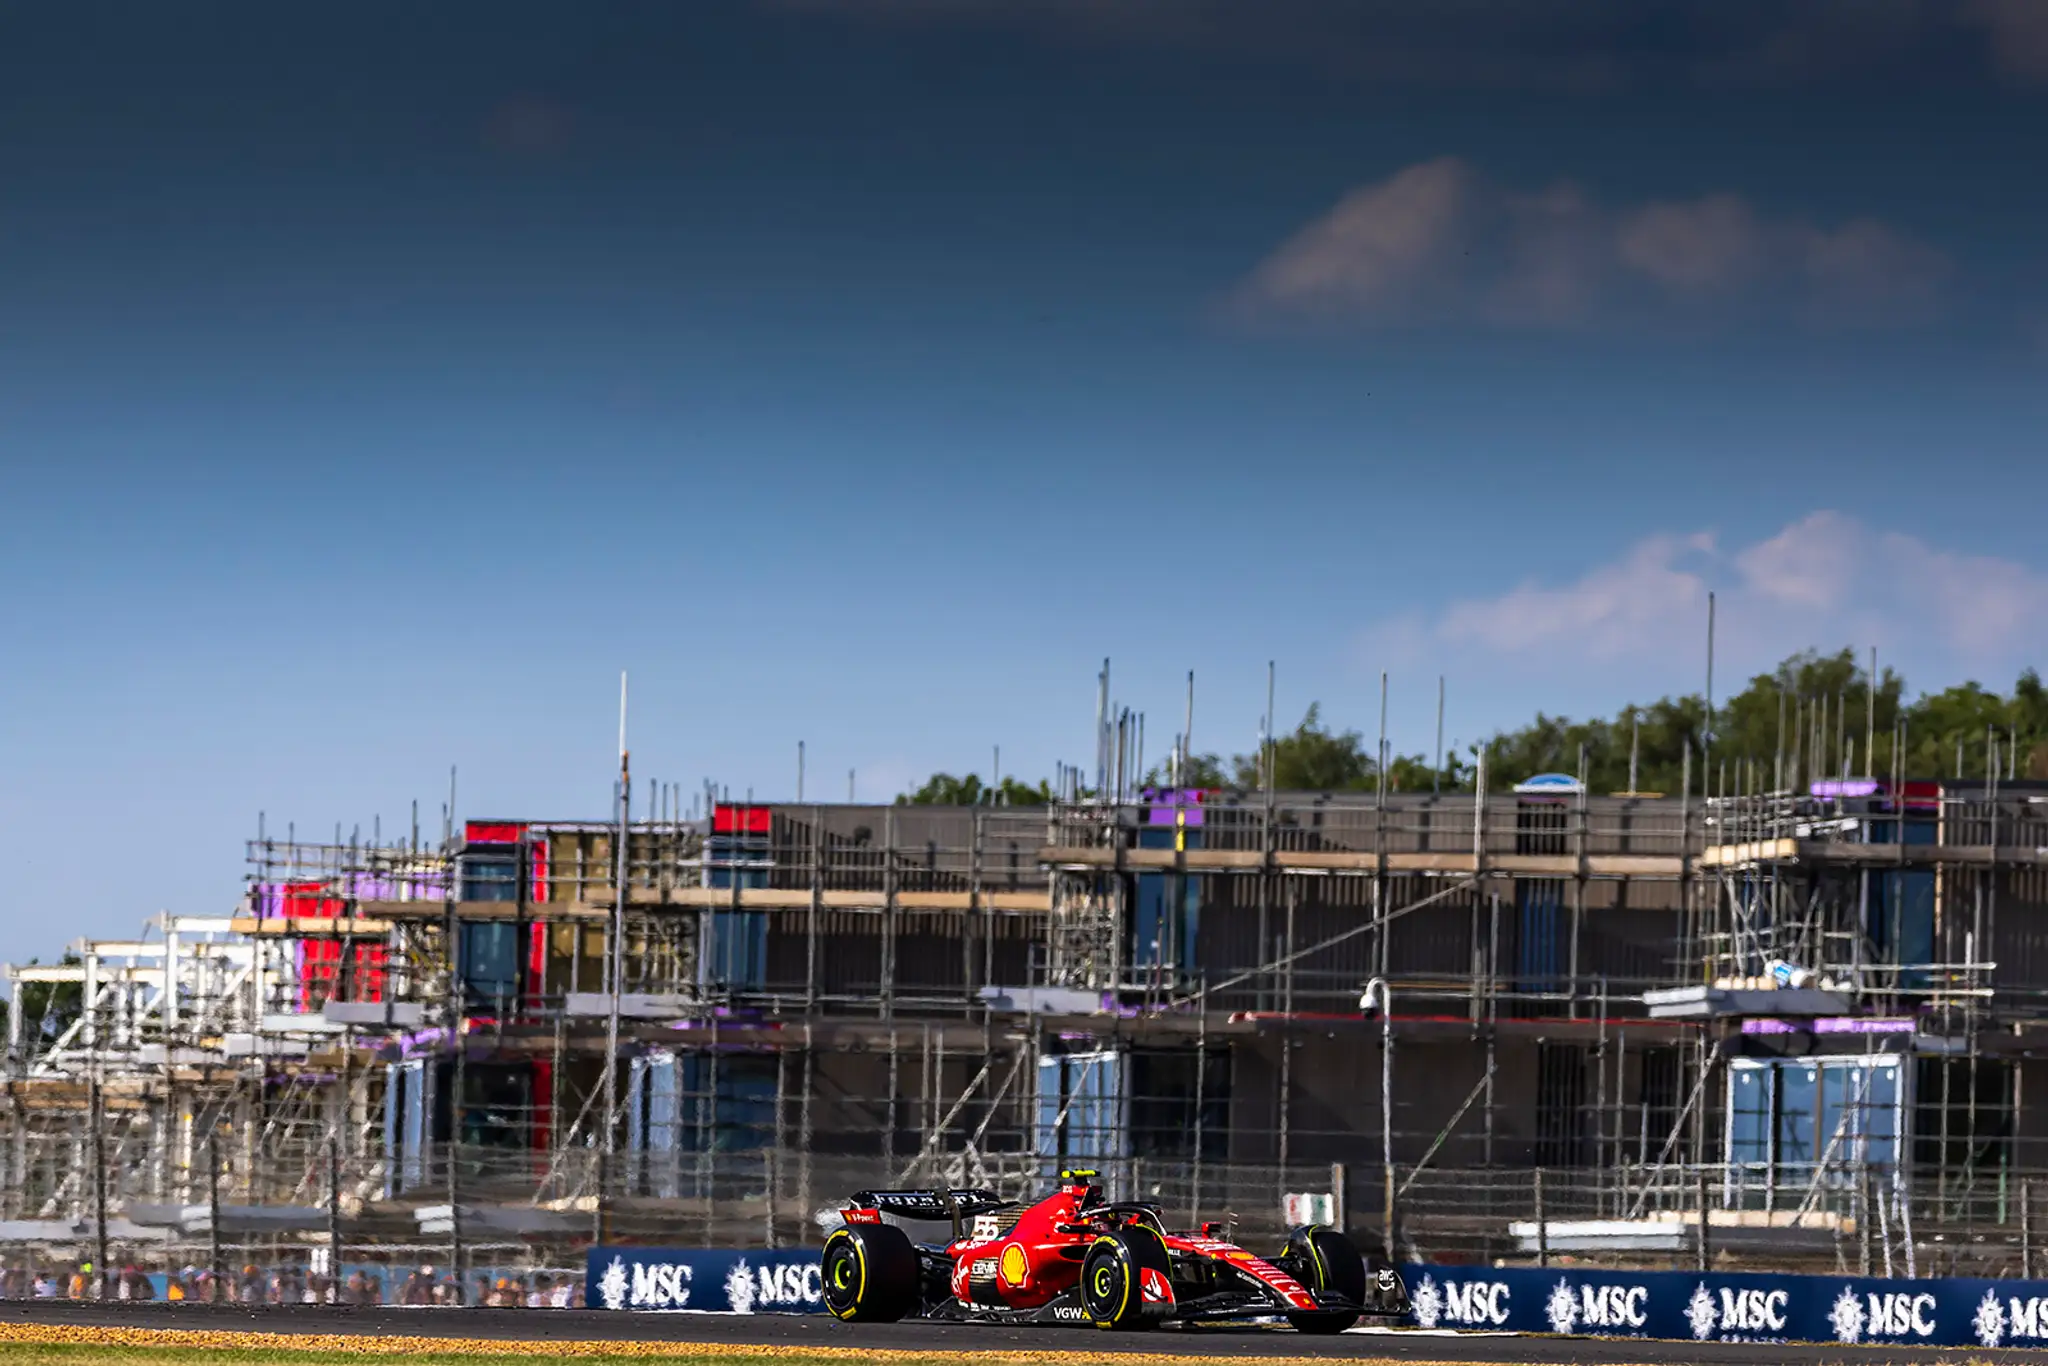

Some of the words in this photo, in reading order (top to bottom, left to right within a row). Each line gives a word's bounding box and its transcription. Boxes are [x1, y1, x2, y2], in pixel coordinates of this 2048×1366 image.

[972, 1215, 999, 1241] 55
[631, 1262, 693, 1306] MSC
[758, 1264, 822, 1306] MSC
[1443, 1281, 1510, 1325] MSC
[1581, 1284, 1649, 1328] MSC
[1054, 1306, 1083, 1319] VGW
[1720, 1287, 1789, 1331] MSC
[1867, 1292, 1937, 1337] MSC
